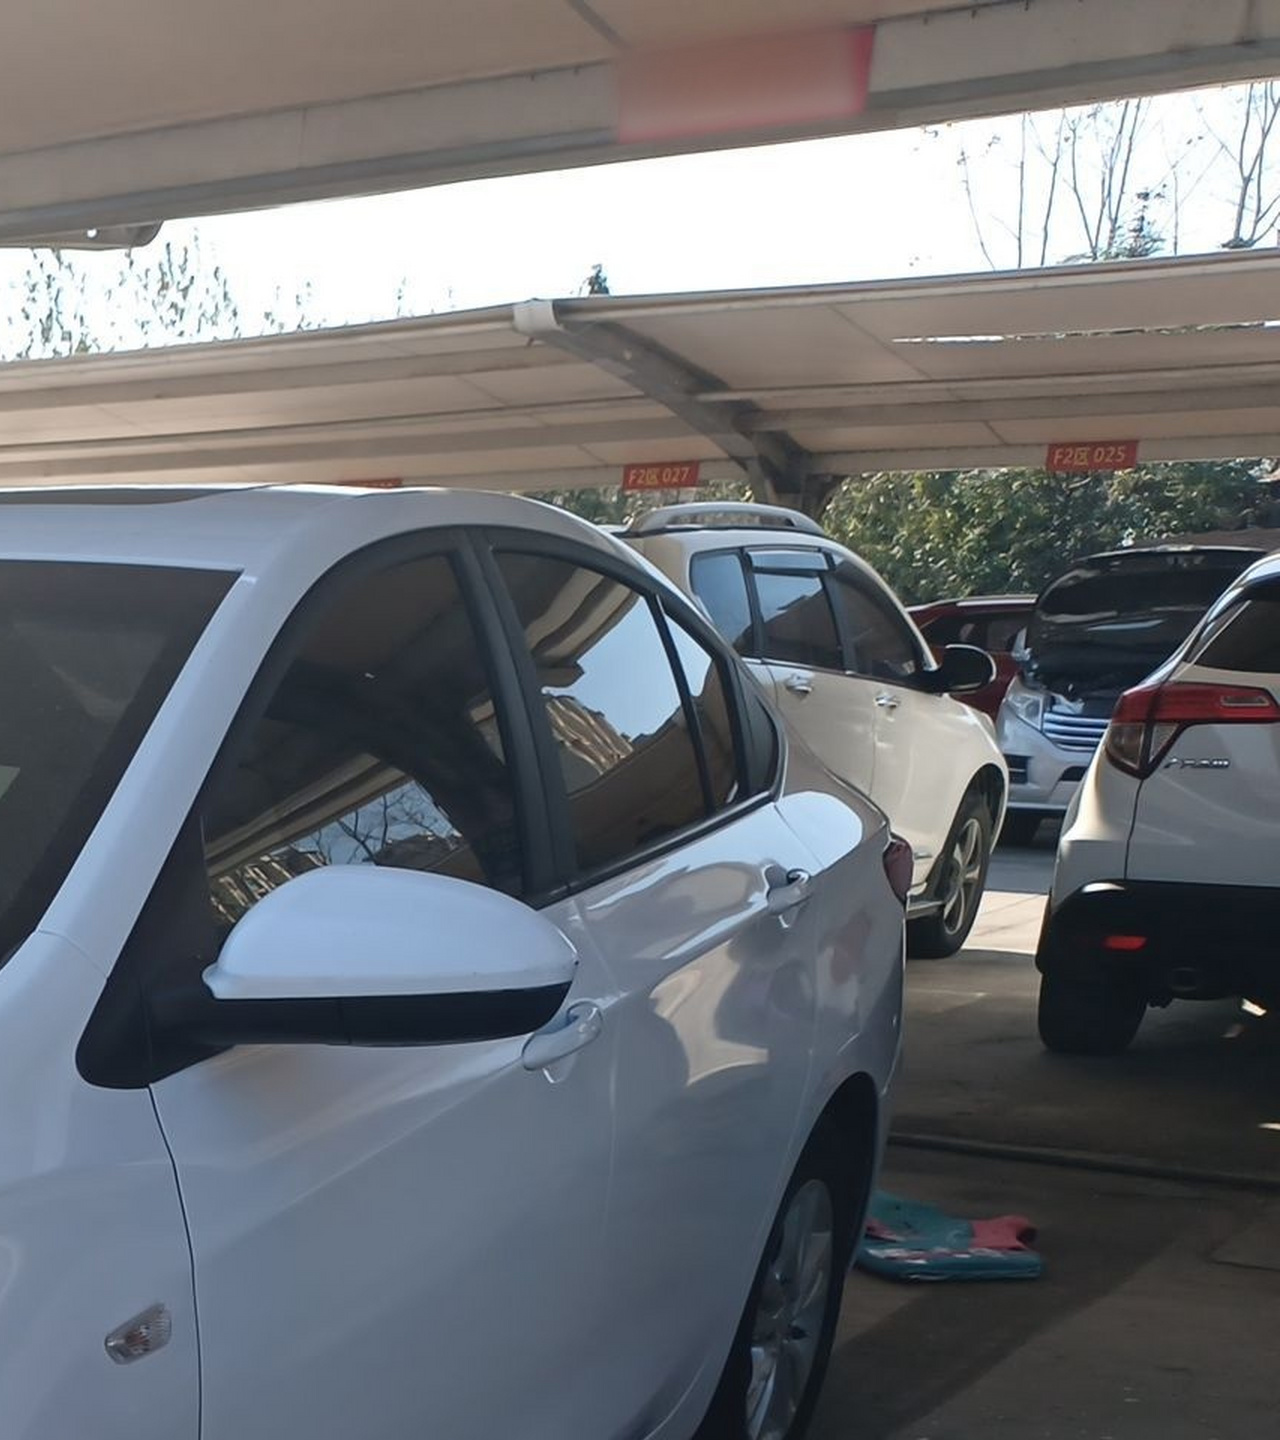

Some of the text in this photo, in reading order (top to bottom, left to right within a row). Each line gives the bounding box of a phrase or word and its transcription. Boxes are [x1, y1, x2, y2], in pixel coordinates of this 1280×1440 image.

[1053, 445, 1126, 466] F2区 025
[628, 467, 690, 486] F2区 027
